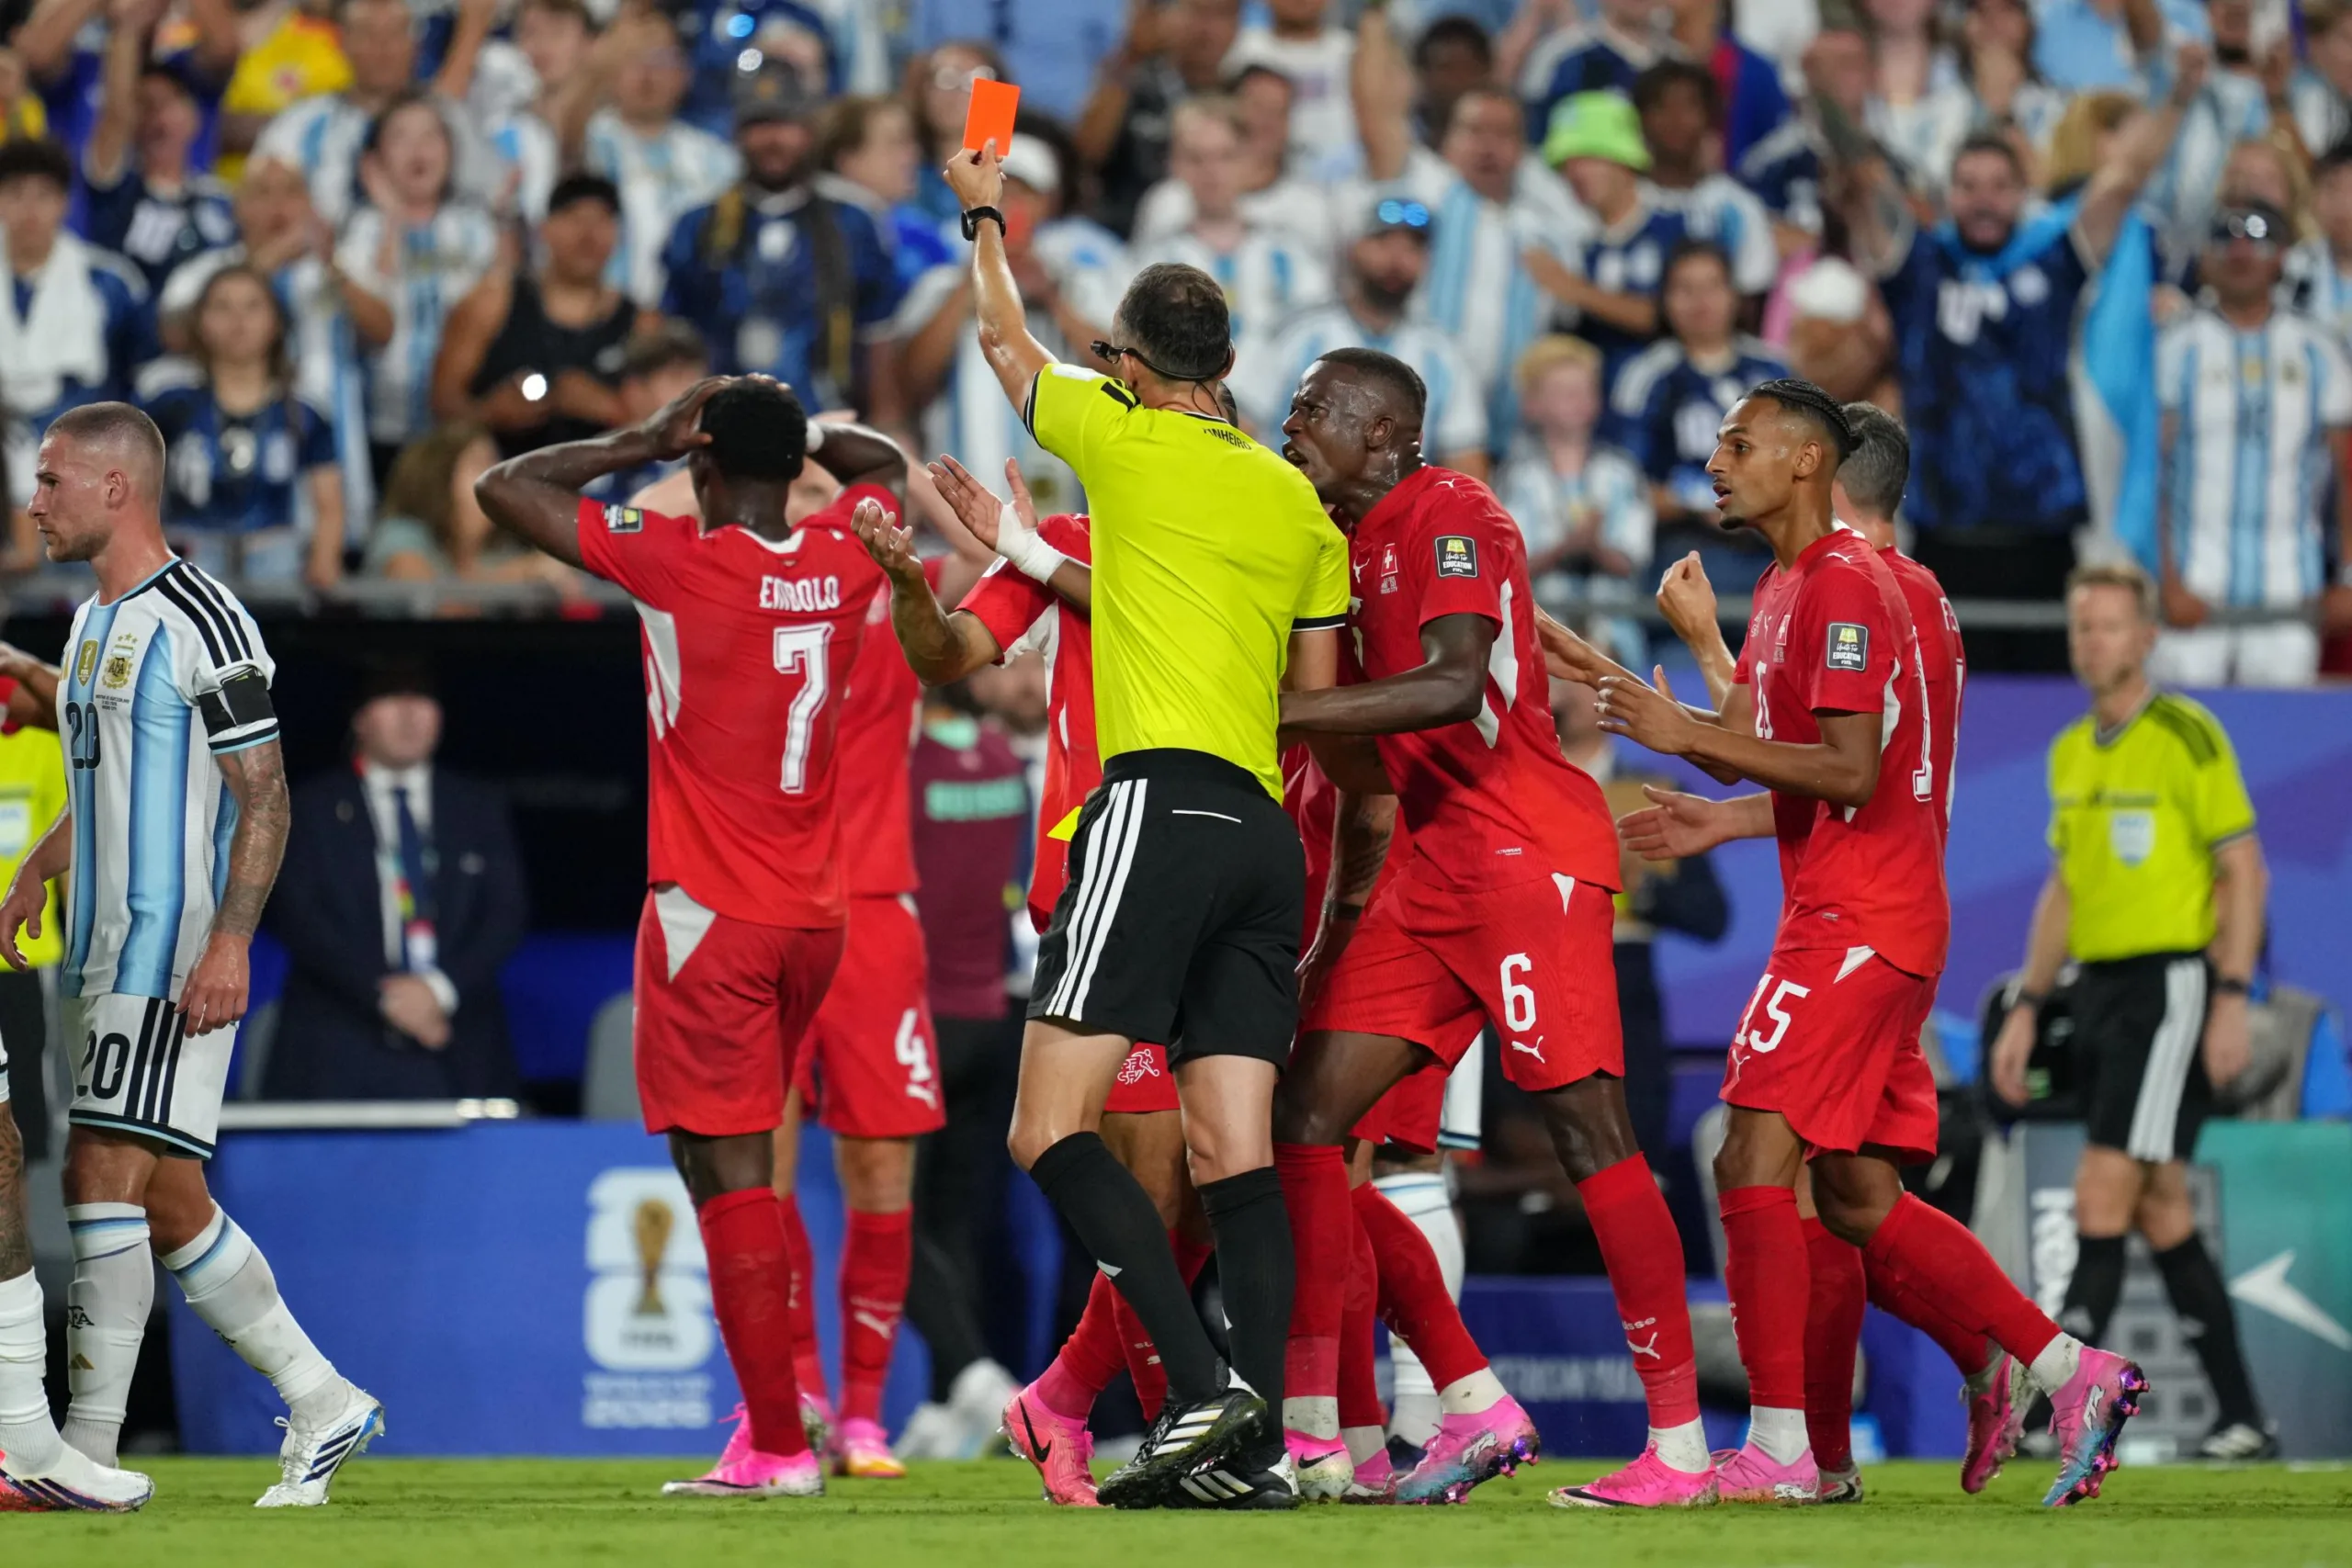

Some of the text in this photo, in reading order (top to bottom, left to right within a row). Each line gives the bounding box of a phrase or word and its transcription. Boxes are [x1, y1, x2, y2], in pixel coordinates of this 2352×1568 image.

[1202, 427, 1252, 451] INHEIRO
[1442, 560, 1472, 570] EDUCATION
[760, 575, 840, 613] EMBOLO
[107, 657, 126, 678] AFA
[1833, 651, 1861, 662] EDUCATION
[774, 621, 835, 795] 7
[65, 701, 101, 770] 20
[1500, 953, 1536, 1032] 6
[1735, 973, 1812, 1054] 15
[76, 1030, 130, 1100] 20
[894, 1008, 933, 1082] 4
[68, 1305, 95, 1330] FA
